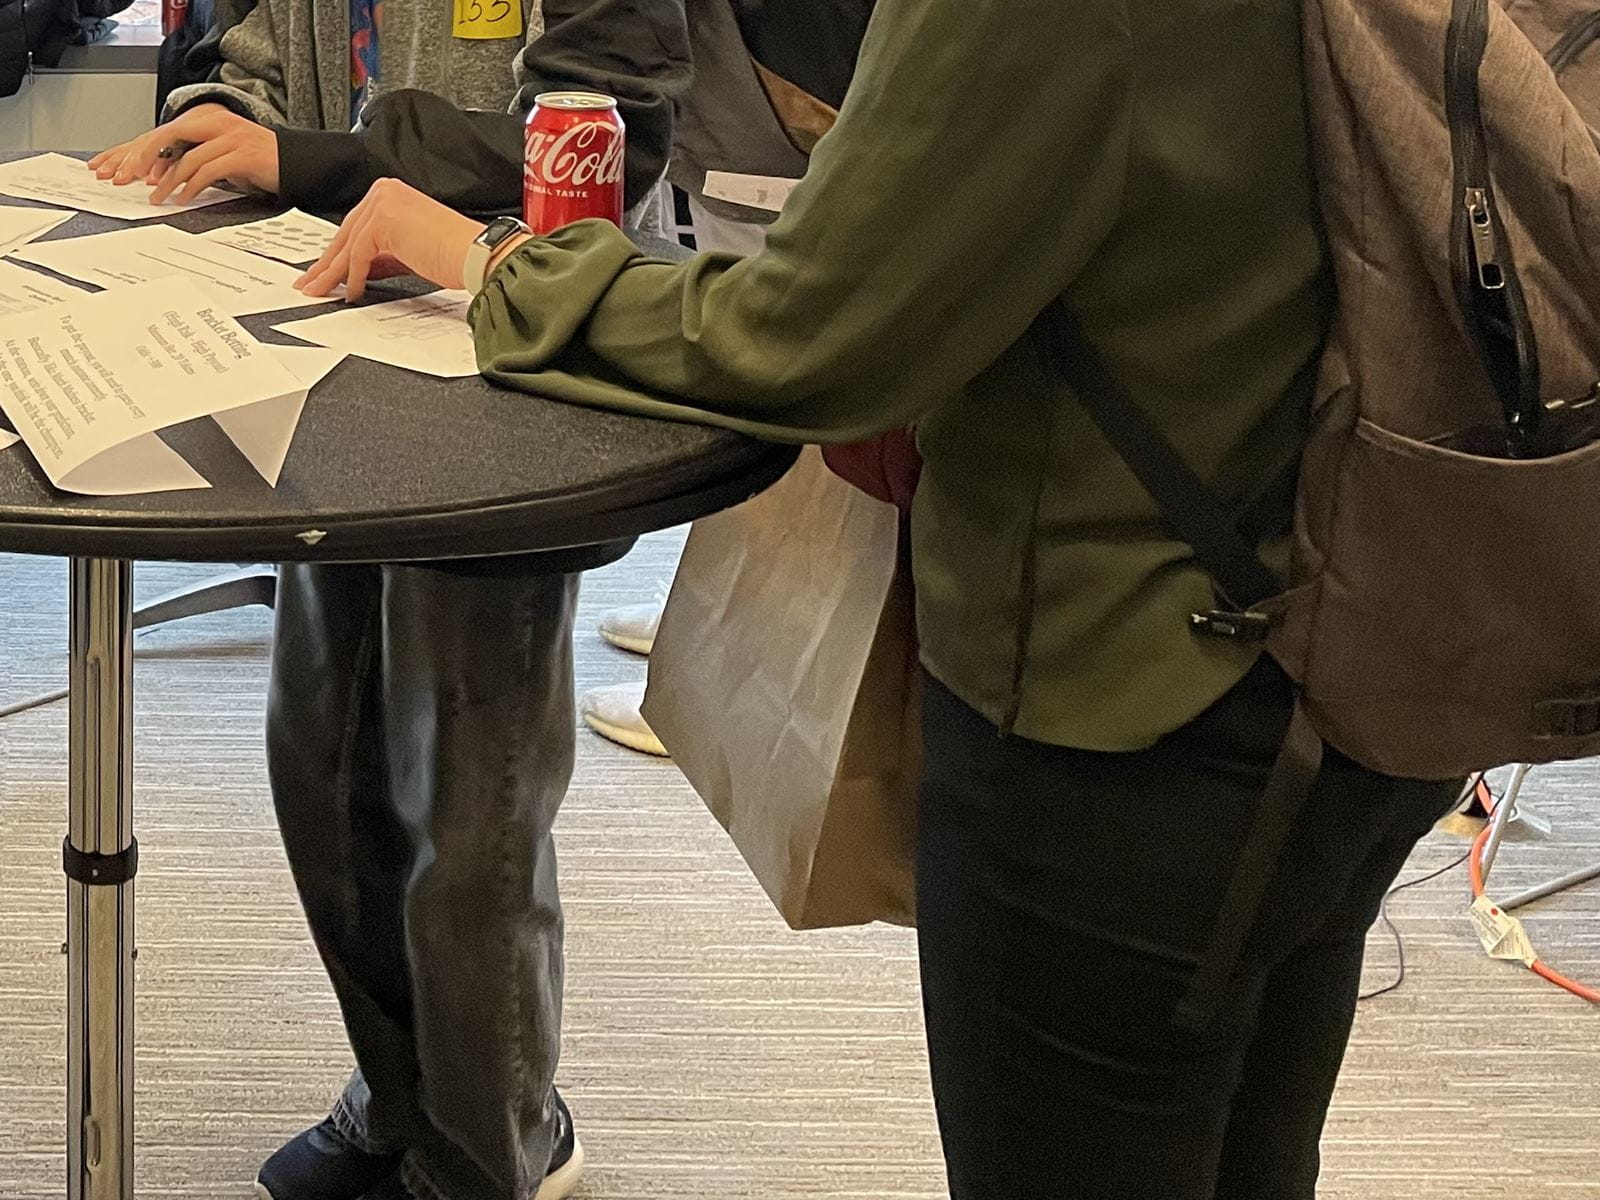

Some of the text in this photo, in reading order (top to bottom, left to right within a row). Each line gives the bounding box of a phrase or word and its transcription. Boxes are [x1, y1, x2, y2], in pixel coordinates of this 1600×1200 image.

[556, 189, 589, 198] TASTE
[196, 307, 228, 334] Bracket
[220, 331, 252, 360] Betting
